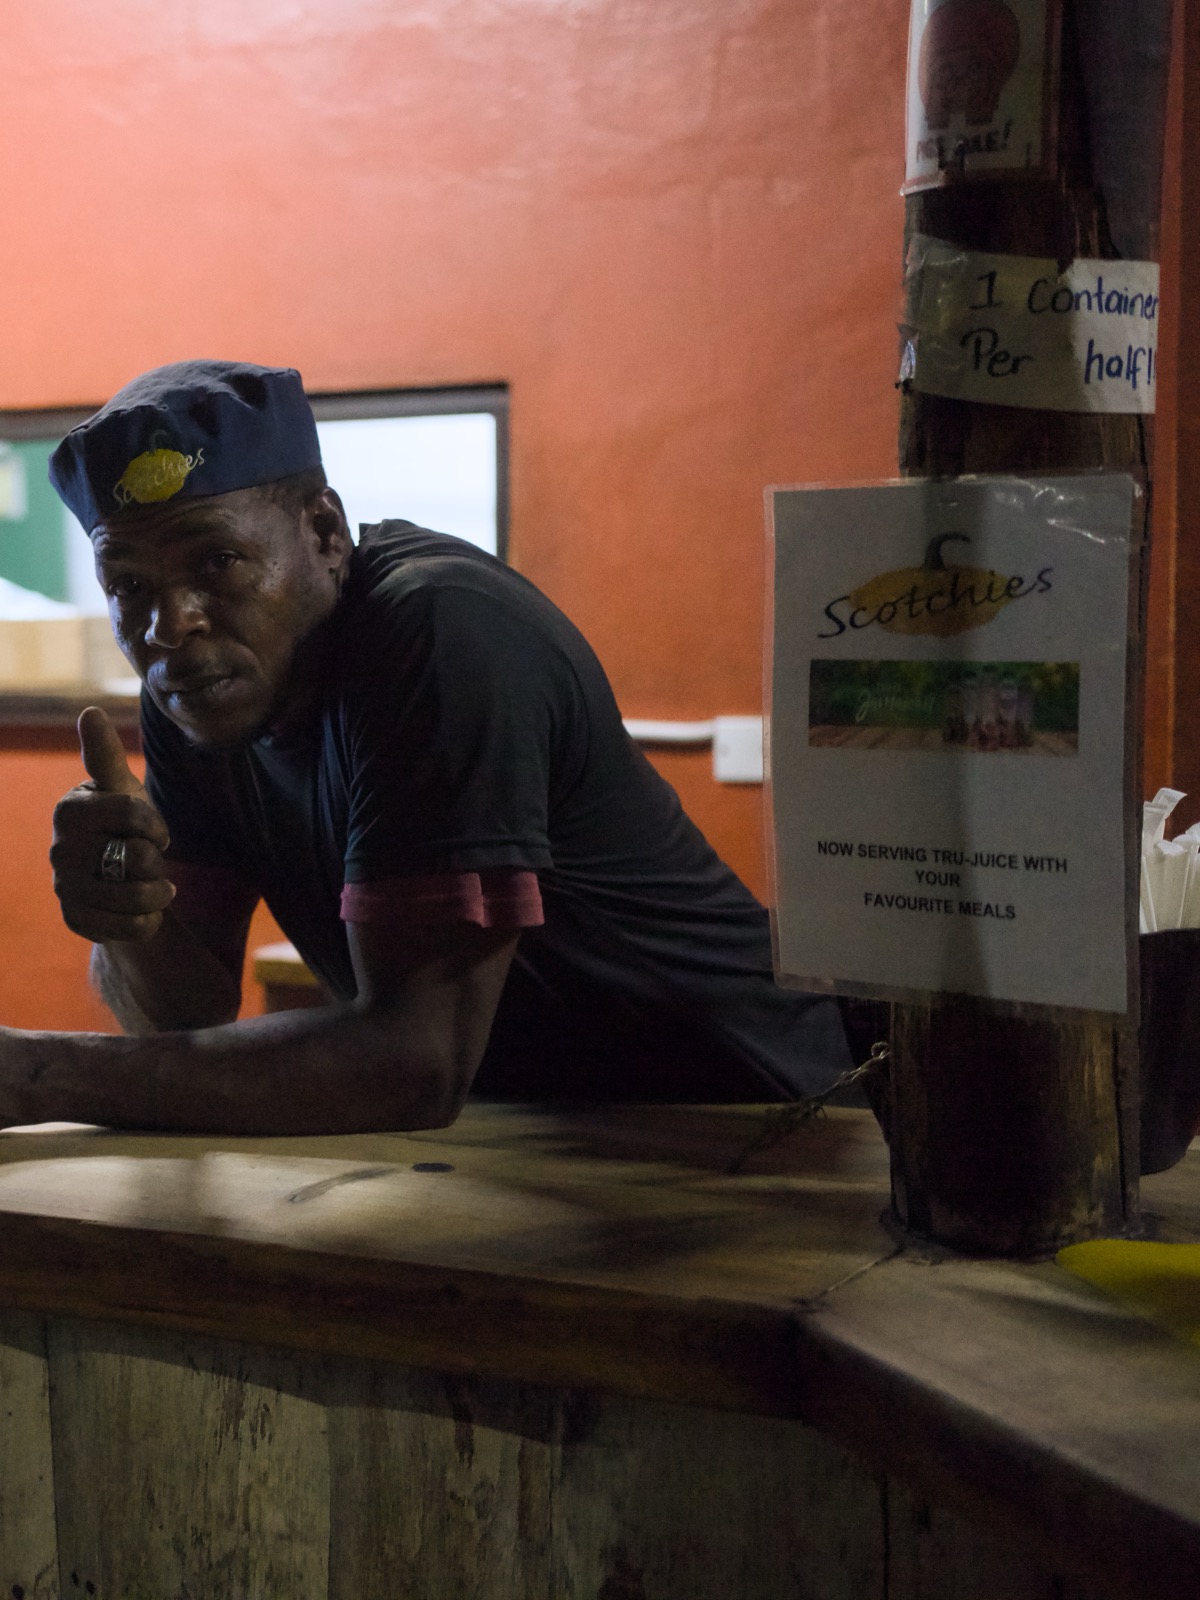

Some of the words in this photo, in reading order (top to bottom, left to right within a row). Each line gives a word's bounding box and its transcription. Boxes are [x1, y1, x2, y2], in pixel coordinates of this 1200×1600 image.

[970, 271, 1003, 311] 1
[959, 327, 1033, 378] Per
[817, 566, 1054, 639] Scotchies
[817, 840, 854, 857] NOW
[857, 843, 927, 863] SERVING
[932, 849, 1019, 870] TRU-JUICE
[1023, 855, 1068, 874] WITH
[915, 869, 961, 888] YOUR
[863, 892, 954, 915] FAVOURITE
[958, 900, 1016, 920] MEALS
